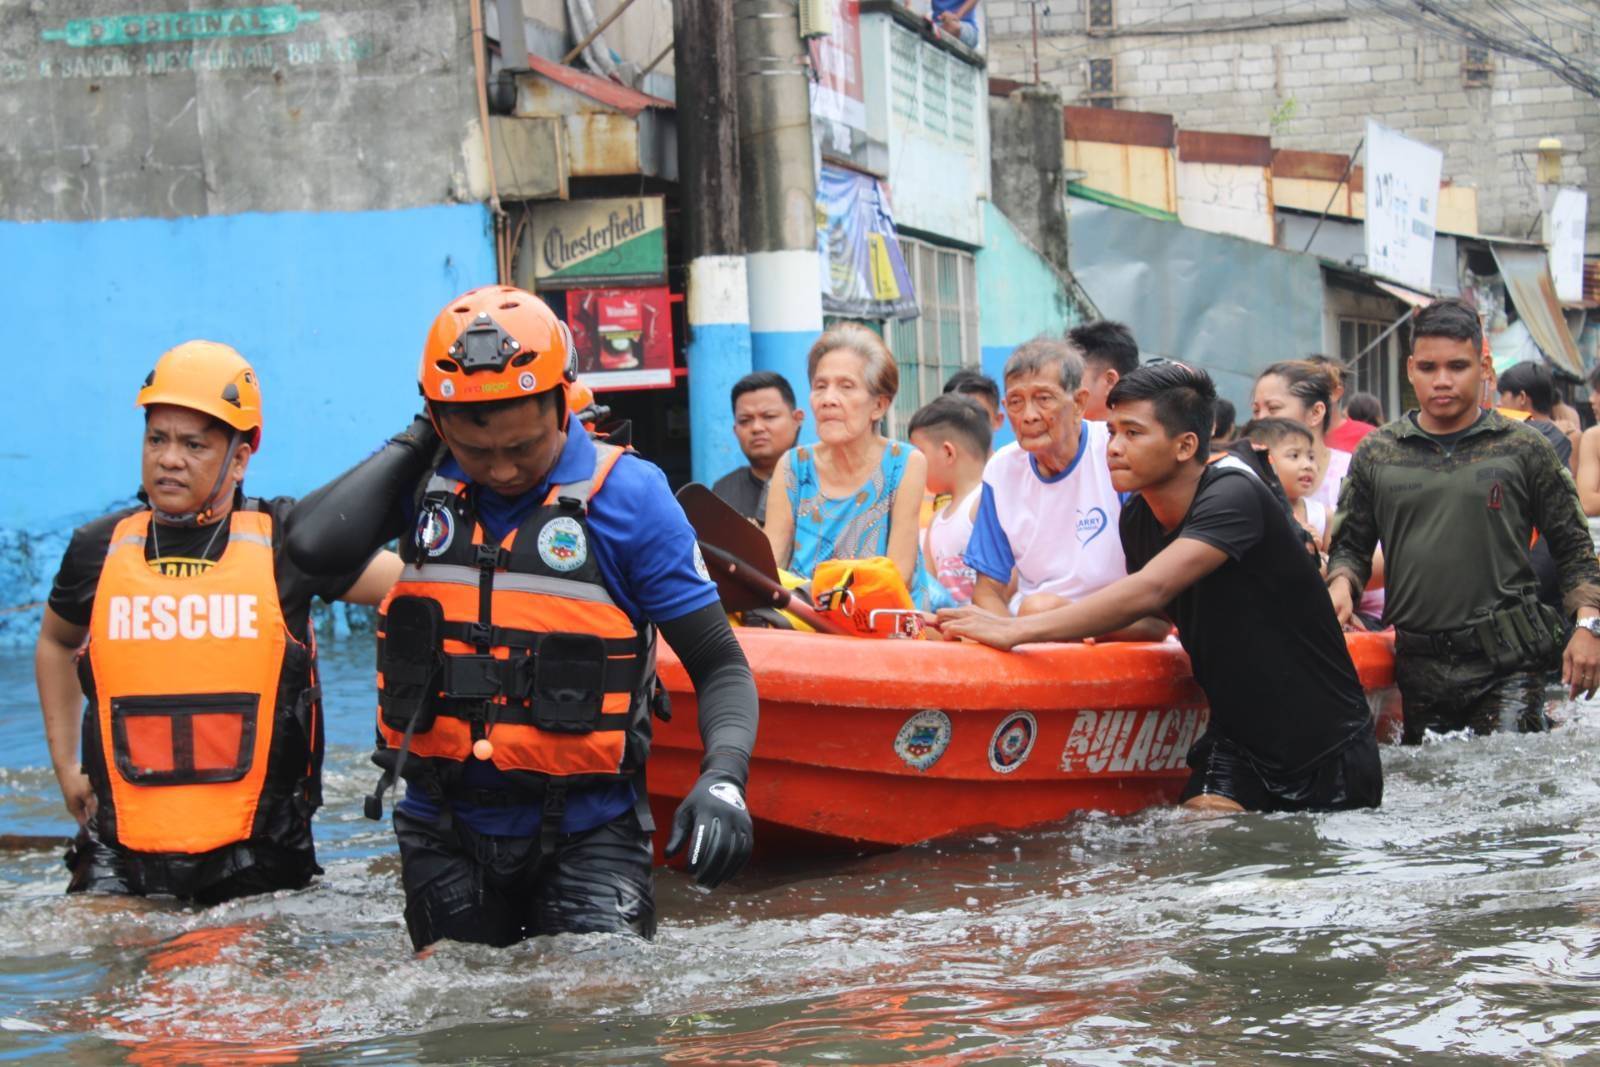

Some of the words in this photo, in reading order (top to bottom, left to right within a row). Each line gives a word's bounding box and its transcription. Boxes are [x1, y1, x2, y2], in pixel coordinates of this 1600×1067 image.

[124, 14, 268, 37] ORIGINAL
[543, 200, 646, 271] Chesterfield
[108, 594, 259, 641] RESCUE
